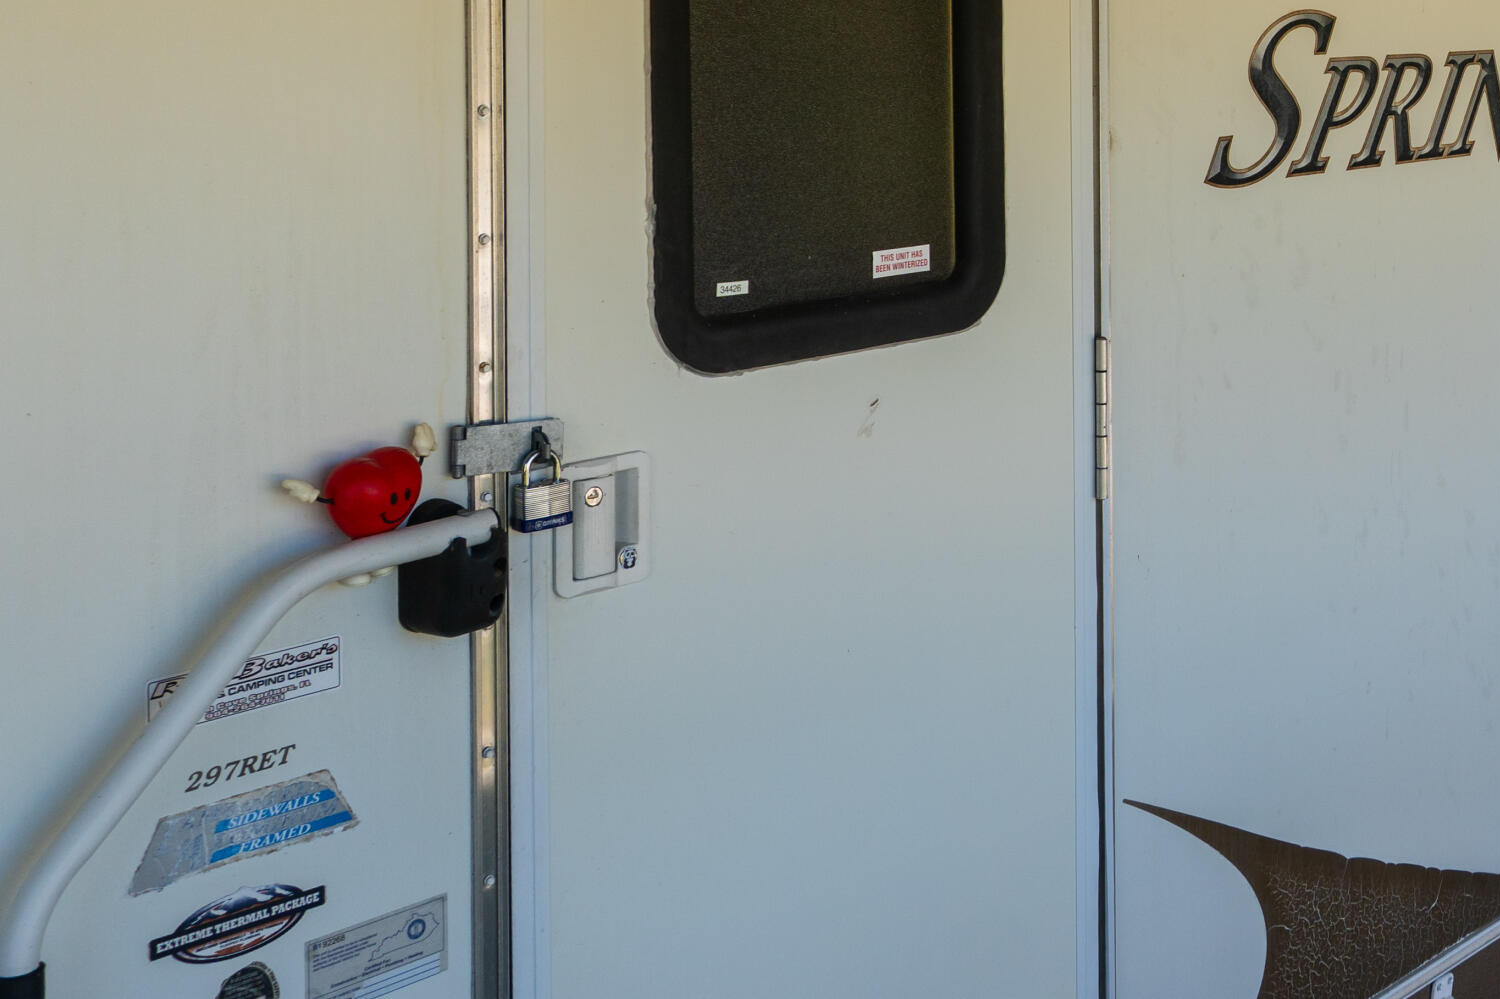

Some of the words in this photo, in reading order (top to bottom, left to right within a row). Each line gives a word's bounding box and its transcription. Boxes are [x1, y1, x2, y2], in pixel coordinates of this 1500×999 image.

[875, 264, 891, 273] BEEN
[892, 259, 928, 271] WINTERIZED
[881, 253, 895, 263] THIS
[896, 251, 910, 261] UNIT
[911, 249, 923, 258] HAS
[233, 643, 338, 680] Baker's
[228, 673, 286, 696] CAMPING
[288, 662, 334, 681] CENTER
[216, 698, 247, 711] Cove
[184, 744, 296, 793] 297RET
[228, 792, 321, 829] SIDEWALLS
[238, 823, 312, 853] FRAMED
[156, 928, 214, 954] EXTREME
[214, 909, 271, 934] THERMAL
[271, 891, 320, 916] PACKAGE
